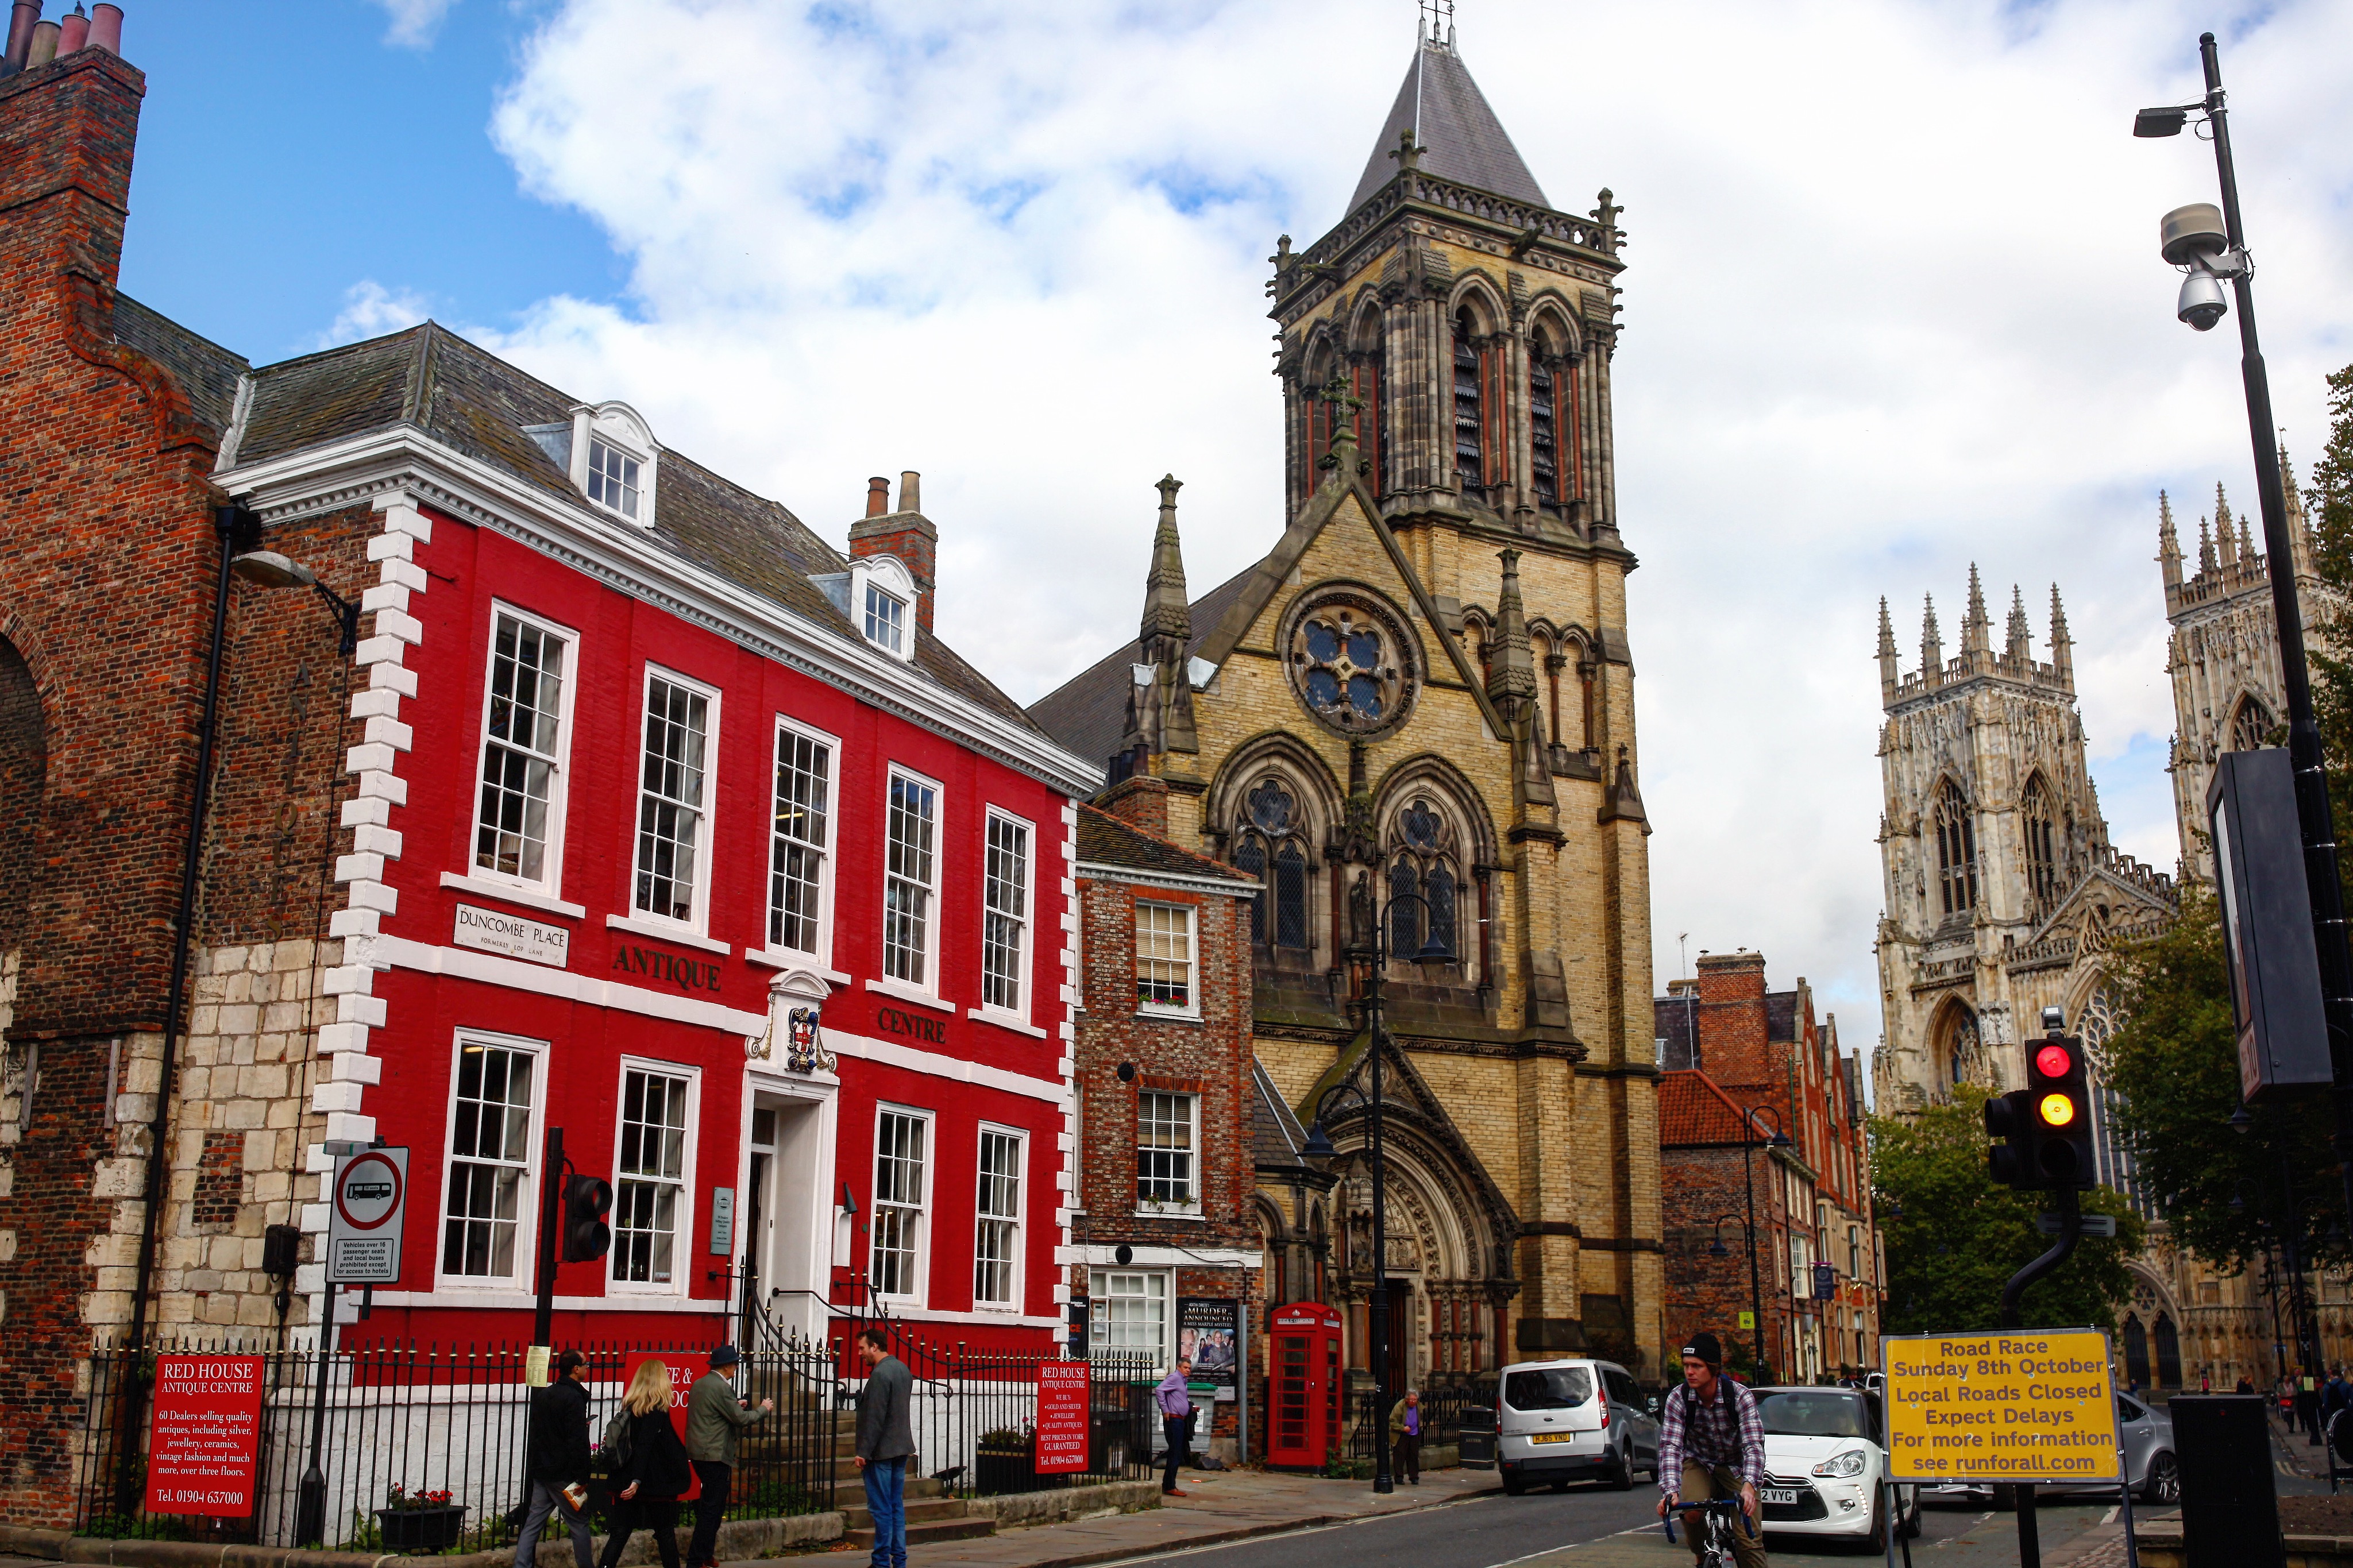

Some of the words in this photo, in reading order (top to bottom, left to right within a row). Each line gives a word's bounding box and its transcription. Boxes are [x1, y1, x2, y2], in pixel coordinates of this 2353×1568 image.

[460, 910, 524, 937] DUNCOMBE
[534, 928, 564, 947] PLACE
[481, 937, 508, 948] FORMERLY
[613, 945, 721, 991] ANTIQUE
[878, 1007, 946, 1044] CENTRE
[1189, 1307, 1226, 1315] MURDER
[1941, 1340, 1991, 1357] Road
[1999, 1340, 2048, 1354] Race
[164, 1364, 194, 1378] RED
[198, 1363, 253, 1378] HOUSE
[1042, 1368, 1058, 1378] RED
[1060, 1368, 1085, 1378] HOUSE
[1895, 1362, 1969, 1378] Sunday
[1977, 1360, 2011, 1374] 8th
[2019, 1358, 2104, 1374] October
[683, 1368, 693, 1384] &
[162, 1382, 207, 1395] ANTIQUE
[210, 1382, 253, 1393] CENTRE
[1042, 1381, 1064, 1389] ANTIQUE
[1897, 1387, 1950, 1403] Local
[1959, 1385, 2020, 1401] Roads
[2028, 1382, 2101, 1399] Closed
[159, 1411, 168, 1419] 60
[170, 1410, 197, 1420] Dealers
[200, 1411, 224, 1423] selling
[226, 1412, 253, 1423] quality
[1926, 1409, 1995, 1427] Expect
[2004, 1407, 2074, 1426] Delays
[158, 1425, 190, 1436] antiques,
[192, 1424, 227, 1436] including
[229, 1426, 252, 1436] silver,
[167, 1438, 202, 1450] jewellery,
[205, 1439, 239, 1449] ceramics,
[1893, 1432, 1925, 1447] For
[1932, 1432, 1983, 1447] more
[1992, 1430, 2112, 1447] information
[1045, 1442, 1080, 1450] GUARANTEED
[156, 1453, 182, 1463] vintage
[184, 1451, 210, 1462] fashion
[213, 1453, 227, 1462] and
[229, 1453, 250, 1462] much
[1041, 1457, 1050, 1465] Tel.
[1051, 1456, 1065, 1465] 01904
[1066, 1455, 1083, 1463] 637000
[1914, 1458, 1948, 1470] see
[1956, 1455, 2095, 1470] runforall.com
[159, 1466, 179, 1475] more,
[199, 1466, 218, 1475] three
[221, 1466, 245, 1476] floors.
[157, 1489, 173, 1501] Tel.
[177, 1490, 205, 1503] 01904
[207, 1491, 242, 1504] 637000
[1771, 1490, 1792, 1501] VYG
